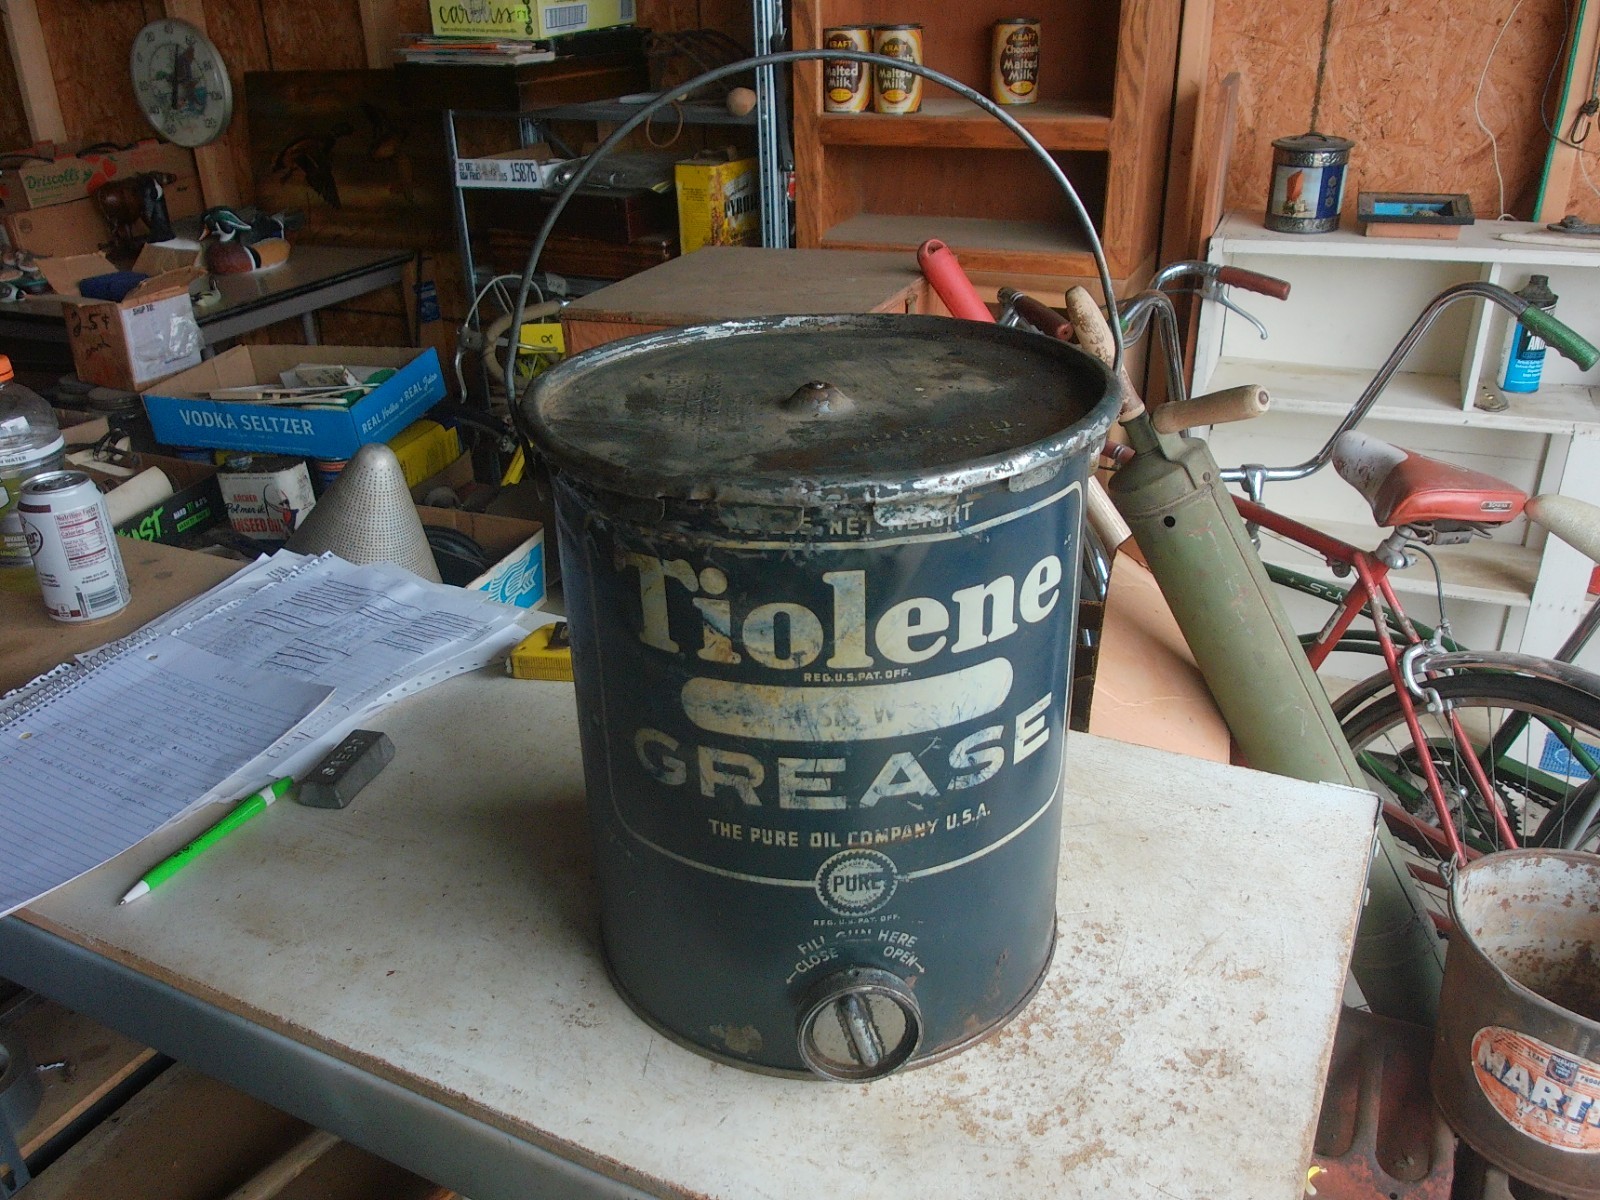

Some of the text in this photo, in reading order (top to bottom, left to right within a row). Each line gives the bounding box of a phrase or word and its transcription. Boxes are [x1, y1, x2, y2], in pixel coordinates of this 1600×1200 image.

[1011, 33, 1037, 41] KRAFT
[1003, 55, 1038, 70] Malted
[829, 77, 852, 89] Milk
[882, 78, 908, 90] Milk
[1008, 69, 1033, 81] Milk
[509, 162, 538, 183] 15876
[361, 413, 382, 434] REAL
[403, 381, 423, 401] REAL
[179, 408, 237, 430] VODKA
[243, 414, 315, 437] SELTZER
[5, 455, 27, 464] WATER
[829, 517, 873, 535] NET
[622, 552, 1062, 670] Tiolene
[634, 692, 1053, 811] GREASE
[708, 802, 991, 848] THE PURE OIL COMPANY U.S.A.
[832, 875, 881, 892] PURE
[877, 928, 919, 949] HERE
[794, 946, 840, 973] CLOSE
[883, 945, 919, 968] OPEN
[1516, 1096, 1581, 1135] WARE
